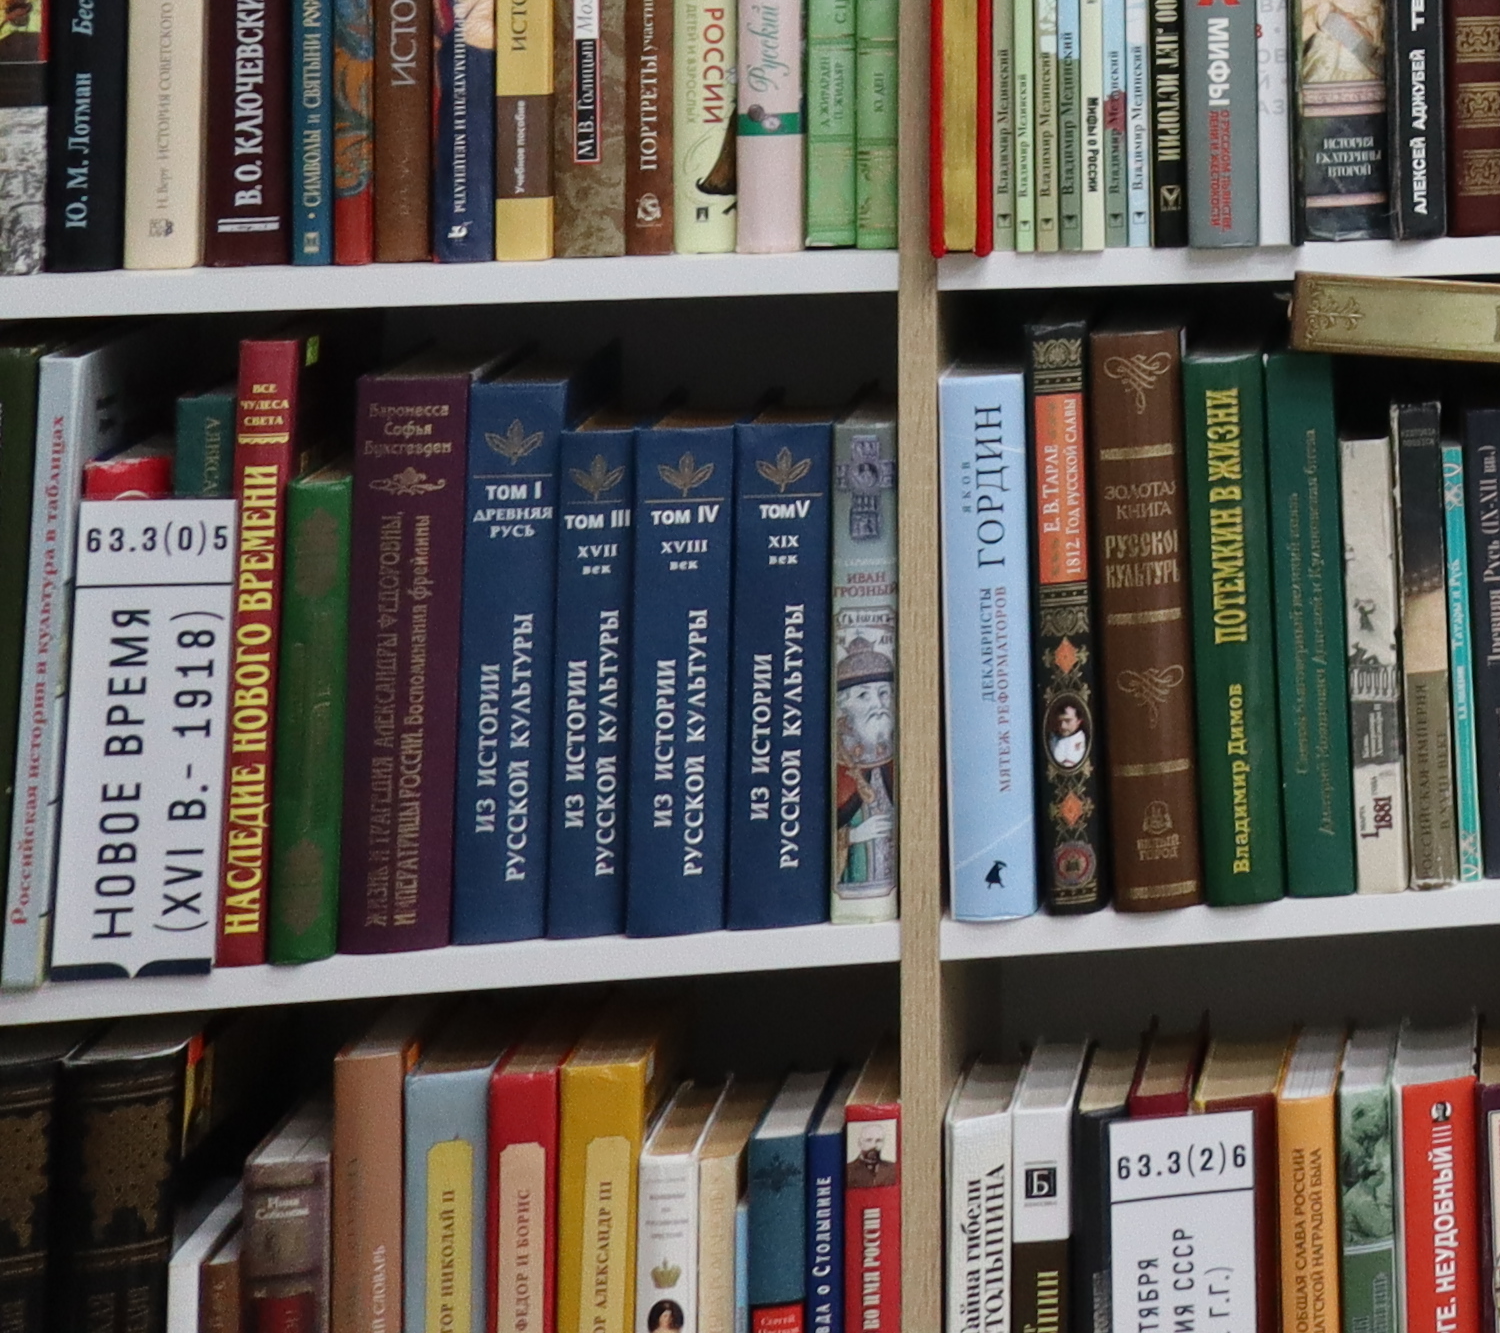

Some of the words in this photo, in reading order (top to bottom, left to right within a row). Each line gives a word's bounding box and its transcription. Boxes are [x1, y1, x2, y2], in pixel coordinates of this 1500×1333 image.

[638, 56, 661, 171] ПОРТРЕТЫ
[1206, 17, 1229, 106] МИФЫ
[236, 159, 264, 181] О.
[236, 184, 263, 206] В.
[84, 526, 230, 552] 63.3(0)5
[242, 464, 279, 612] ВРЕМЕНИ
[974, 404, 1009, 568] ГОРДИН
[105, 607, 150, 756] ВРЕМЯ
[170, 610, 224, 738] 1918)
[234, 623, 274, 749] НОВОГО
[654, 659, 677, 781] ИСТОРИИ
[685, 608, 711, 744] КУЛЬТУРЫ
[92, 782, 142, 940] НОВОЕ
[223, 762, 269, 934] НАСЛЕДИЕ
[653, 793, 674, 828] ИЗ
[683, 755, 707, 876] РУССКОЙ
[153, 847, 210, 934] (XVI
[1118, 1144, 1247, 1180] 63.3(2)6
[1433, 1145, 1457, 1292] НЕУДОБНЫЙ
[1172, 1228, 1194, 1300] СССР
